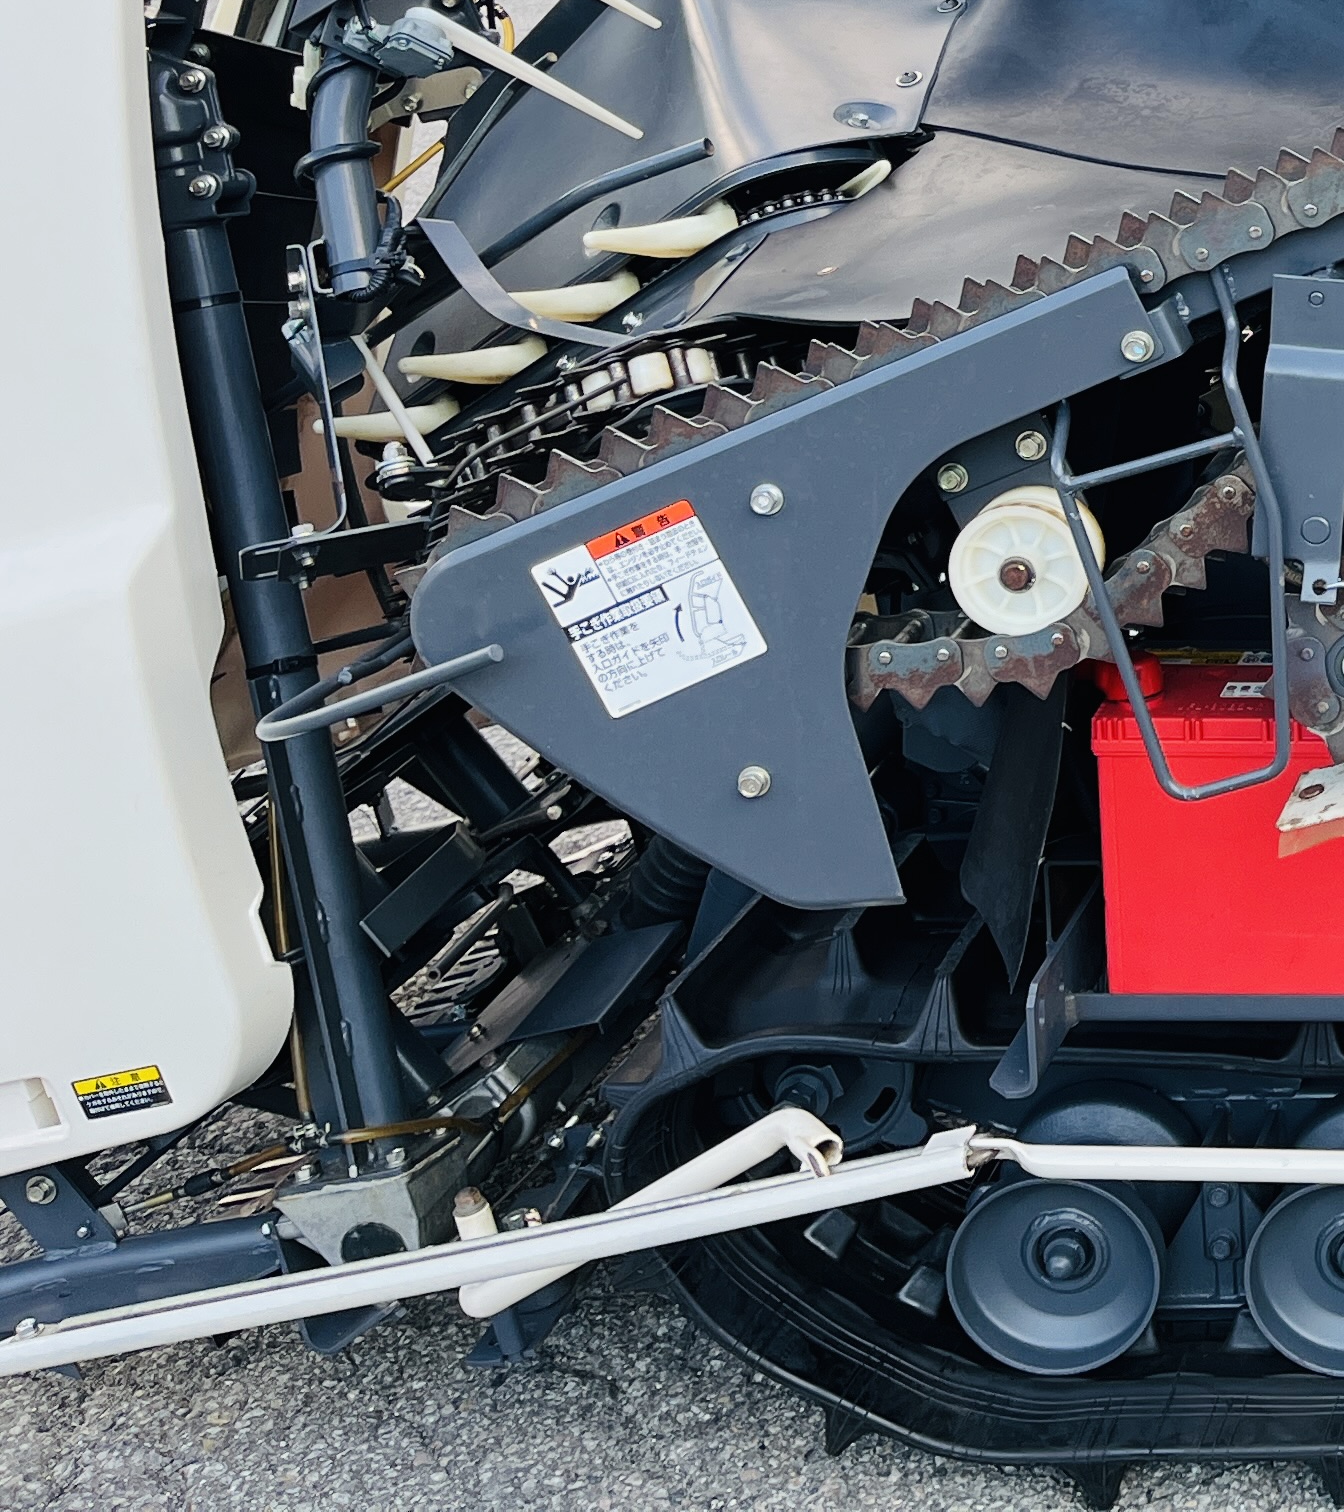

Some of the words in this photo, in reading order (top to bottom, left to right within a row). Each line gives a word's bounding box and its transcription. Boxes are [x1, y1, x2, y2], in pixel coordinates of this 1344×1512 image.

[631, 515, 671, 538] 警告
[580, 624, 640, 652] 手こぎ作業を
[592, 632, 670, 673] 入口ガイドを矢印
[597, 649, 666, 683] の方向に上げて
[604, 672, 648, 692] ください。
